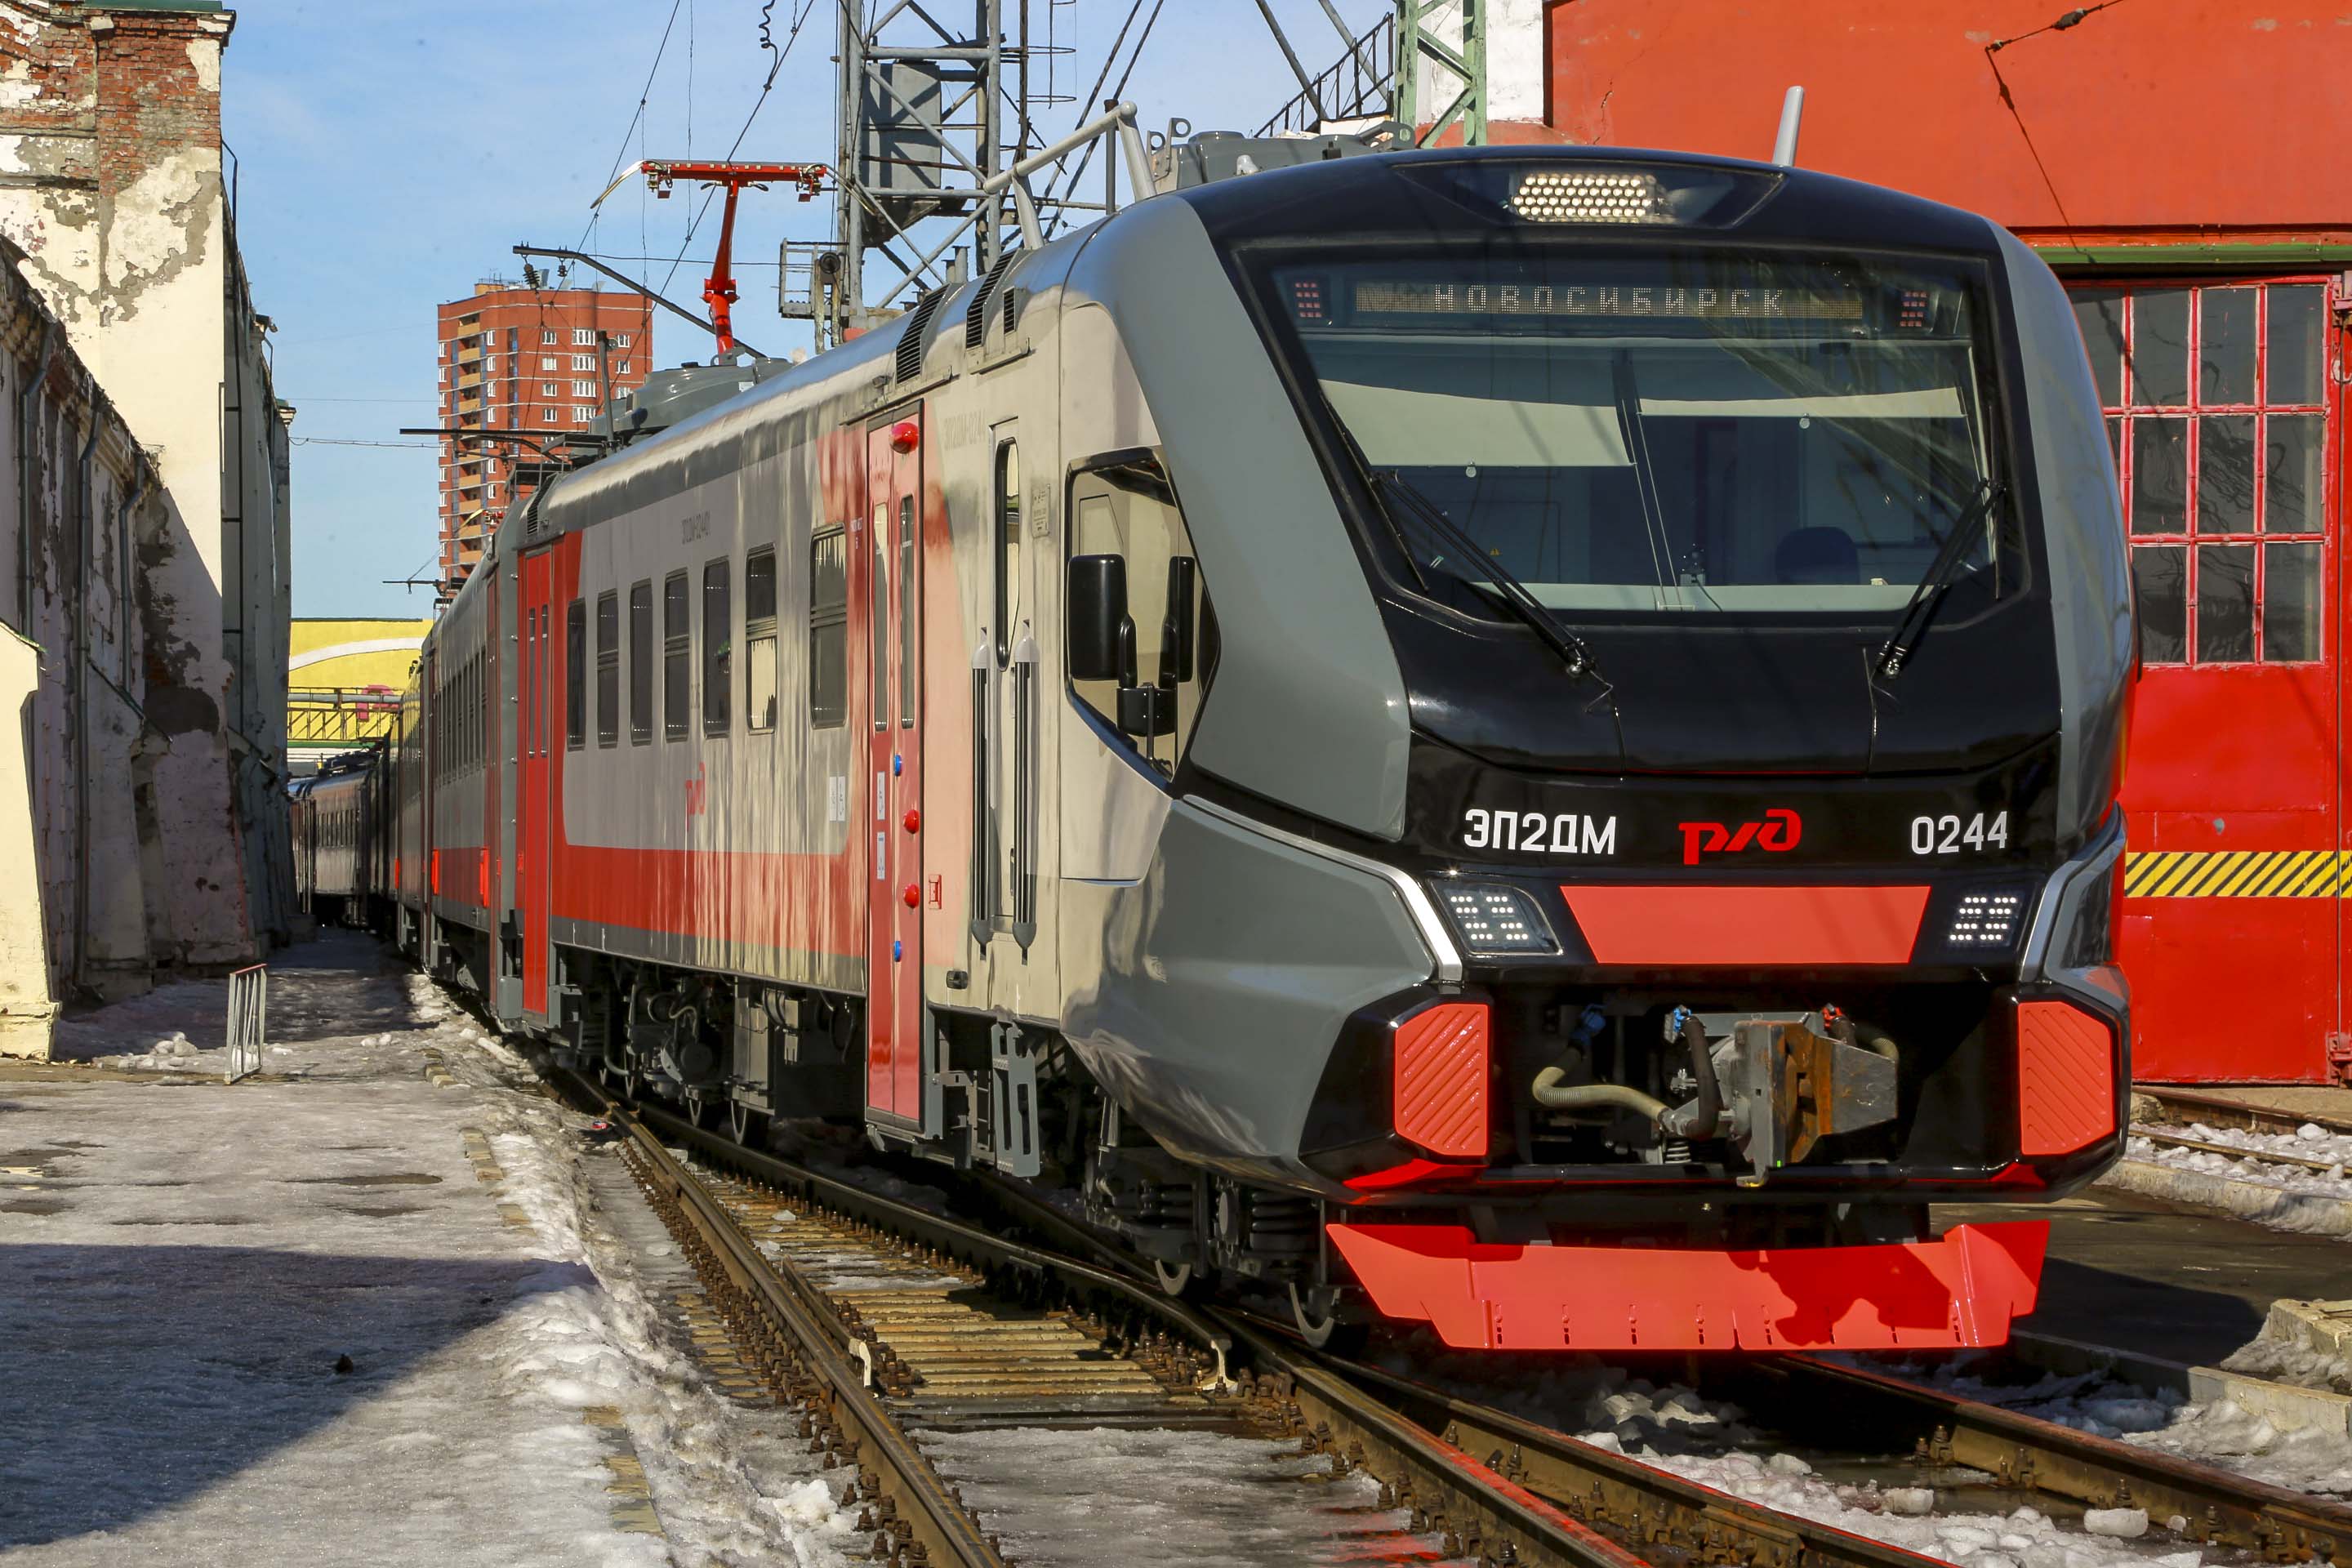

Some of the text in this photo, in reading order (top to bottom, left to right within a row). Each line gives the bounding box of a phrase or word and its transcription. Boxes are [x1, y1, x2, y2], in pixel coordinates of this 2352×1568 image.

[1435, 283, 1783, 316] НОВОСИБИРСК
[1464, 808, 1616, 855] ЭП2ДМ
[1912, 811, 2007, 854] 0244
